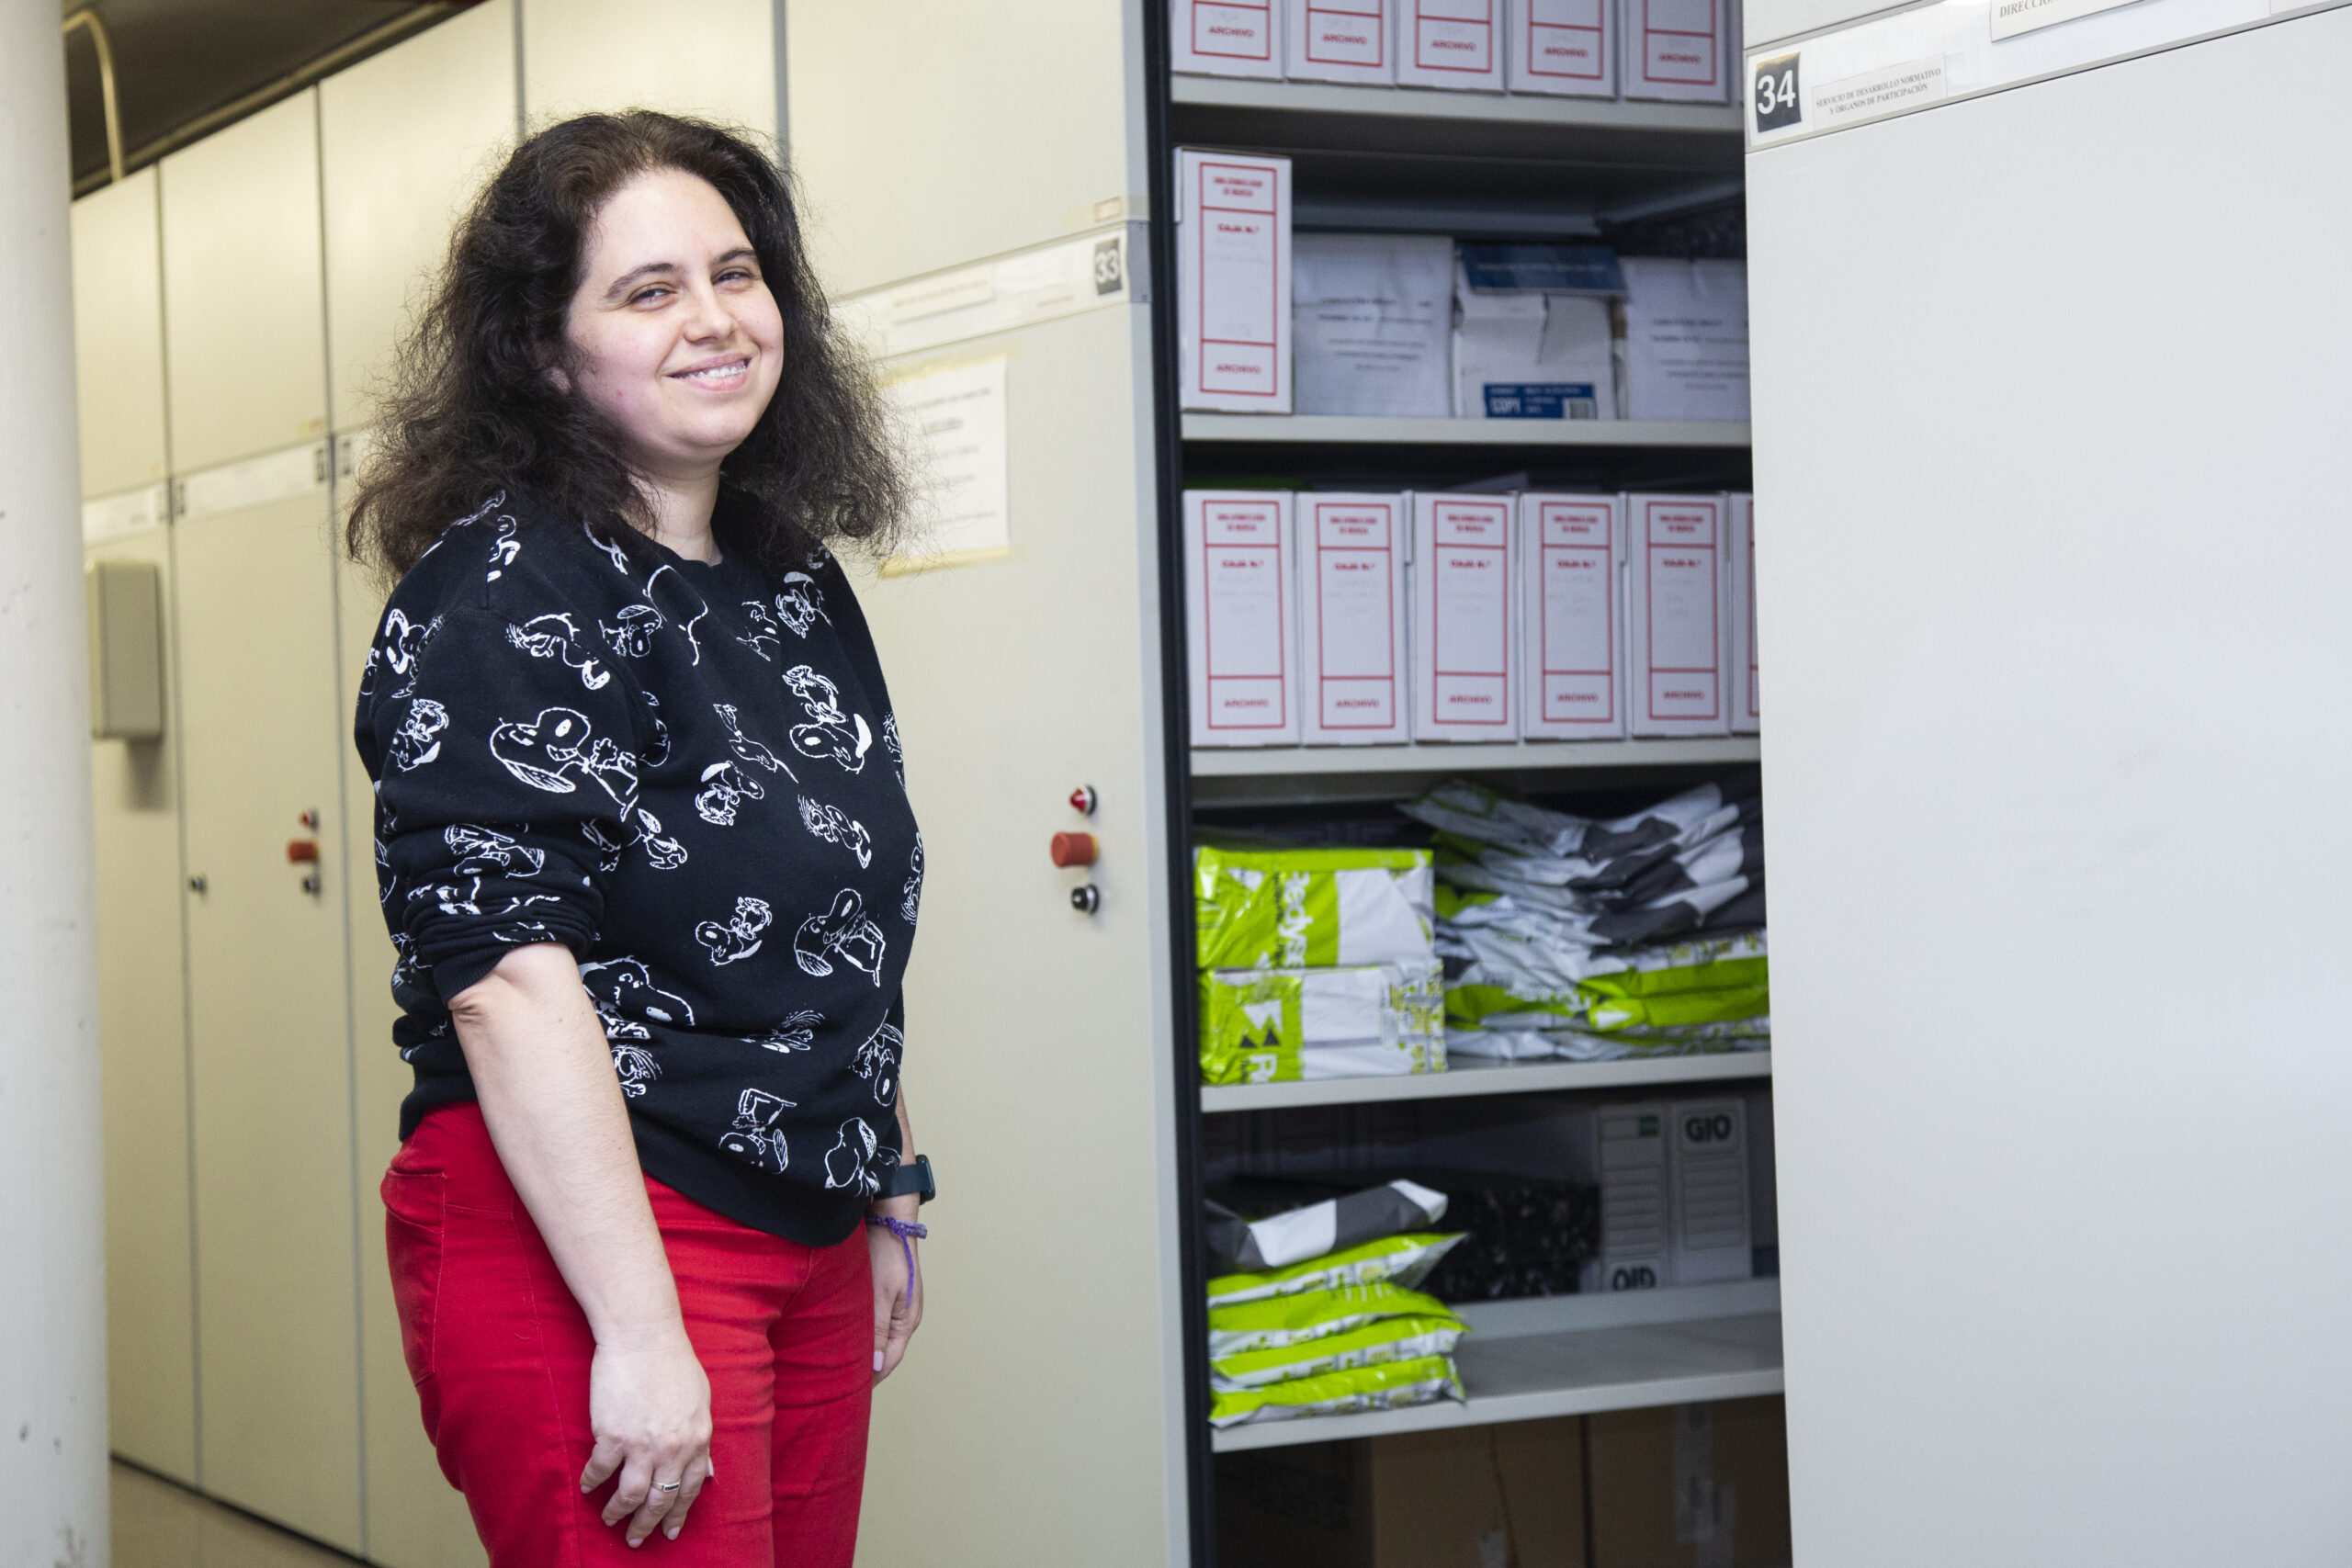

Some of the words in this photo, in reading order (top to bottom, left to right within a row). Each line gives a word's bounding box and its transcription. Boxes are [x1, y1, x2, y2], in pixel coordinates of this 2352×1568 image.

[1999, 0, 2056, 18] DIRECCI
[1757, 69, 1796, 115] 34
[1815, 94, 1846, 108] SERVICIO
[1856, 79, 1900, 97] DESARROLLO
[1900, 68, 1941, 85] NORMATIVO
[1877, 83, 1928, 104] PARTICIPACIÓN
[1096, 249, 1118, 283] 33
[1685, 1114, 1732, 1143] GIO
